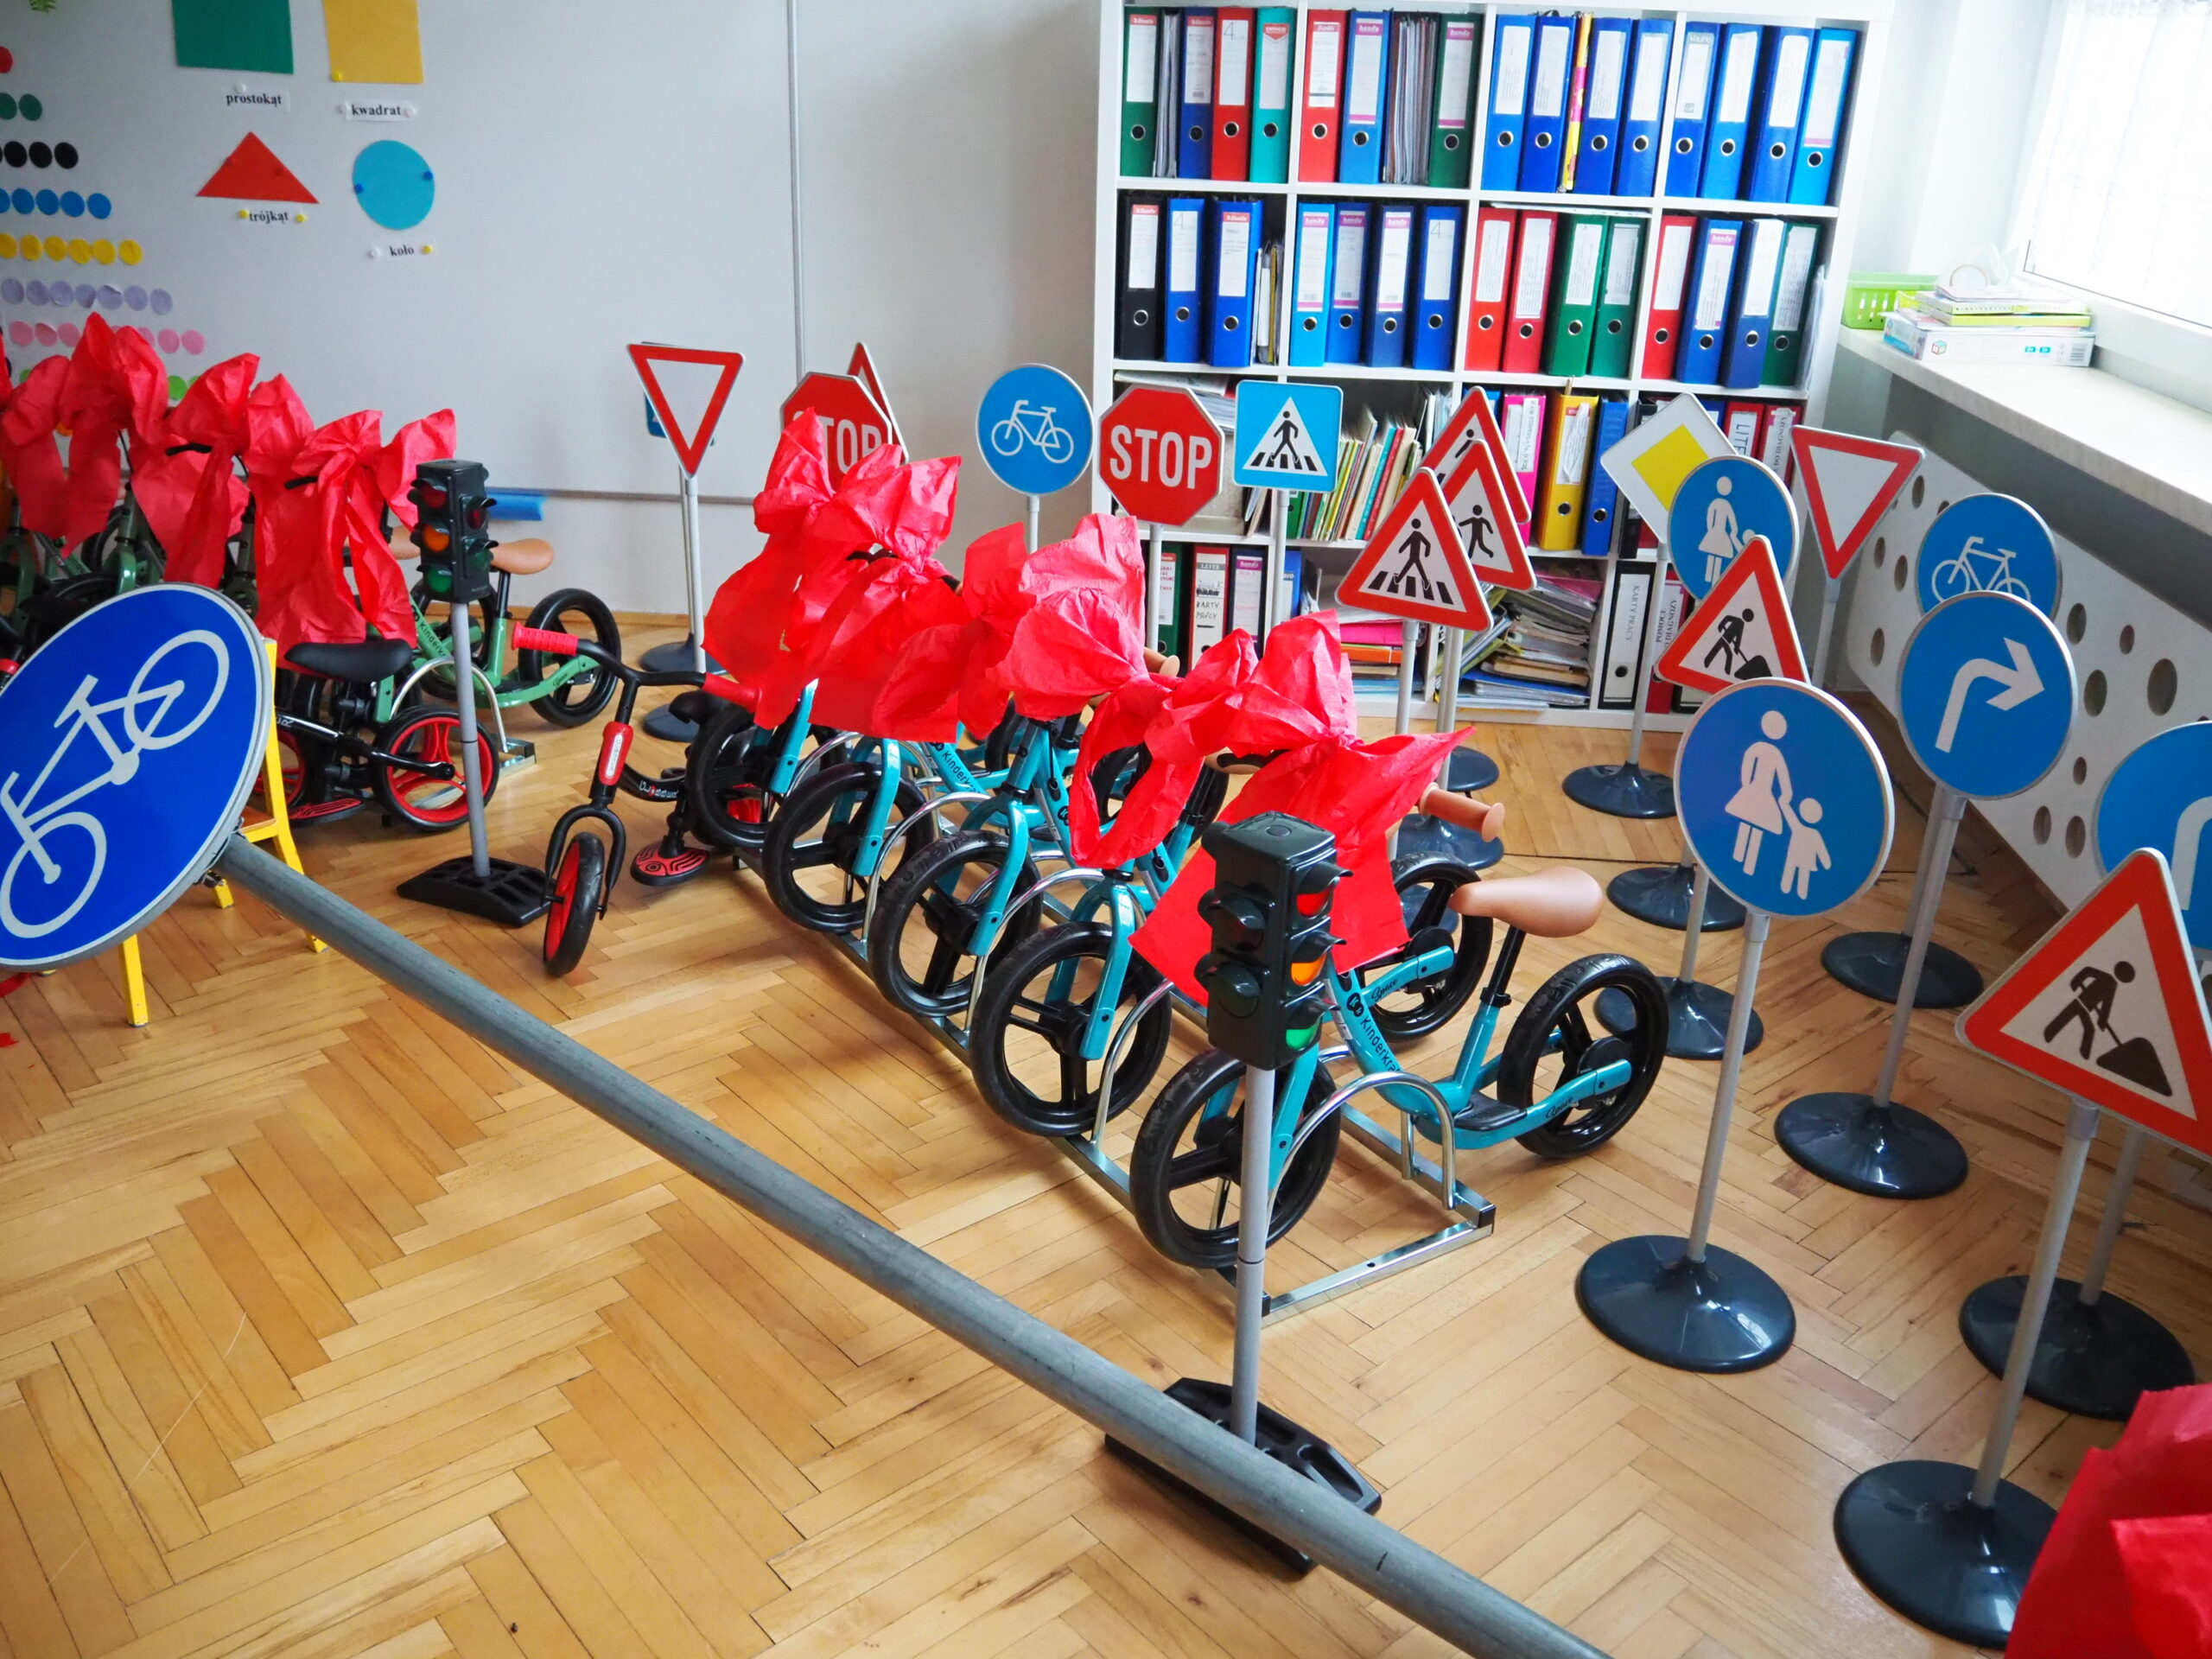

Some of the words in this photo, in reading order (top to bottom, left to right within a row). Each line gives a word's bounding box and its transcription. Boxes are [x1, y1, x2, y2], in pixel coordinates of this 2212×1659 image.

[226, 93, 282, 107] prostokąt
[352, 104, 401, 116] kwadrat
[792, 410, 882, 475] TOP
[1109, 424, 1212, 490] STOP
